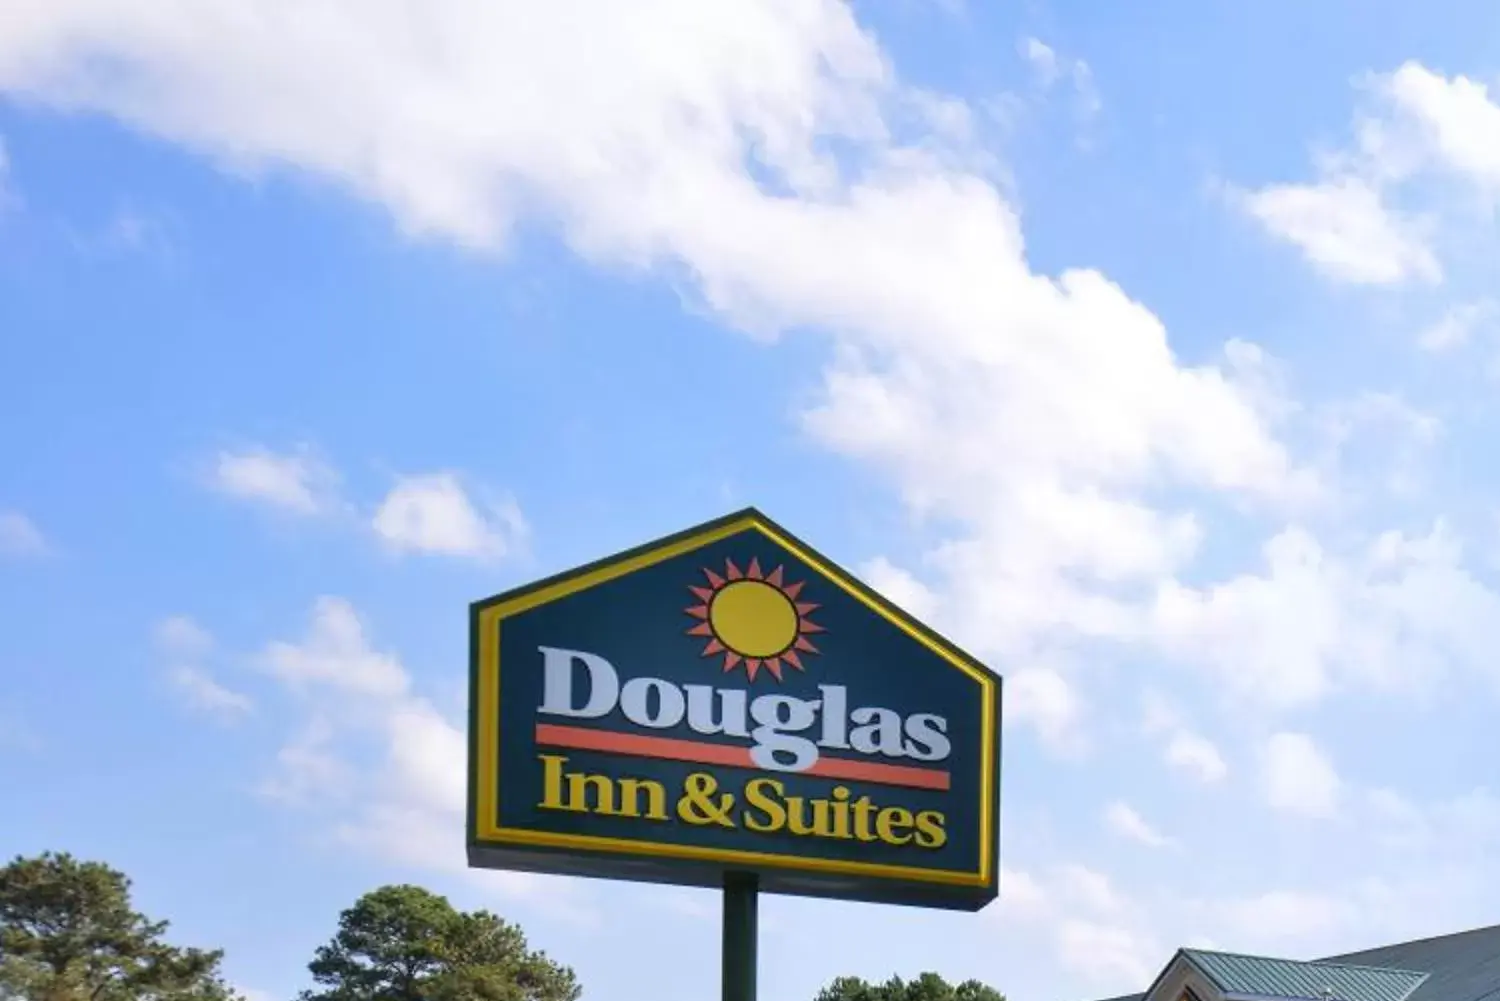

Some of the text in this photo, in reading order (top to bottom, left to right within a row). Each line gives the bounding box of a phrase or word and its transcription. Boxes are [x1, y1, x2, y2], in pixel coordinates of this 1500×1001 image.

[537, 645, 951, 772] Douglas
[537, 755, 948, 848] Inn & Suites
